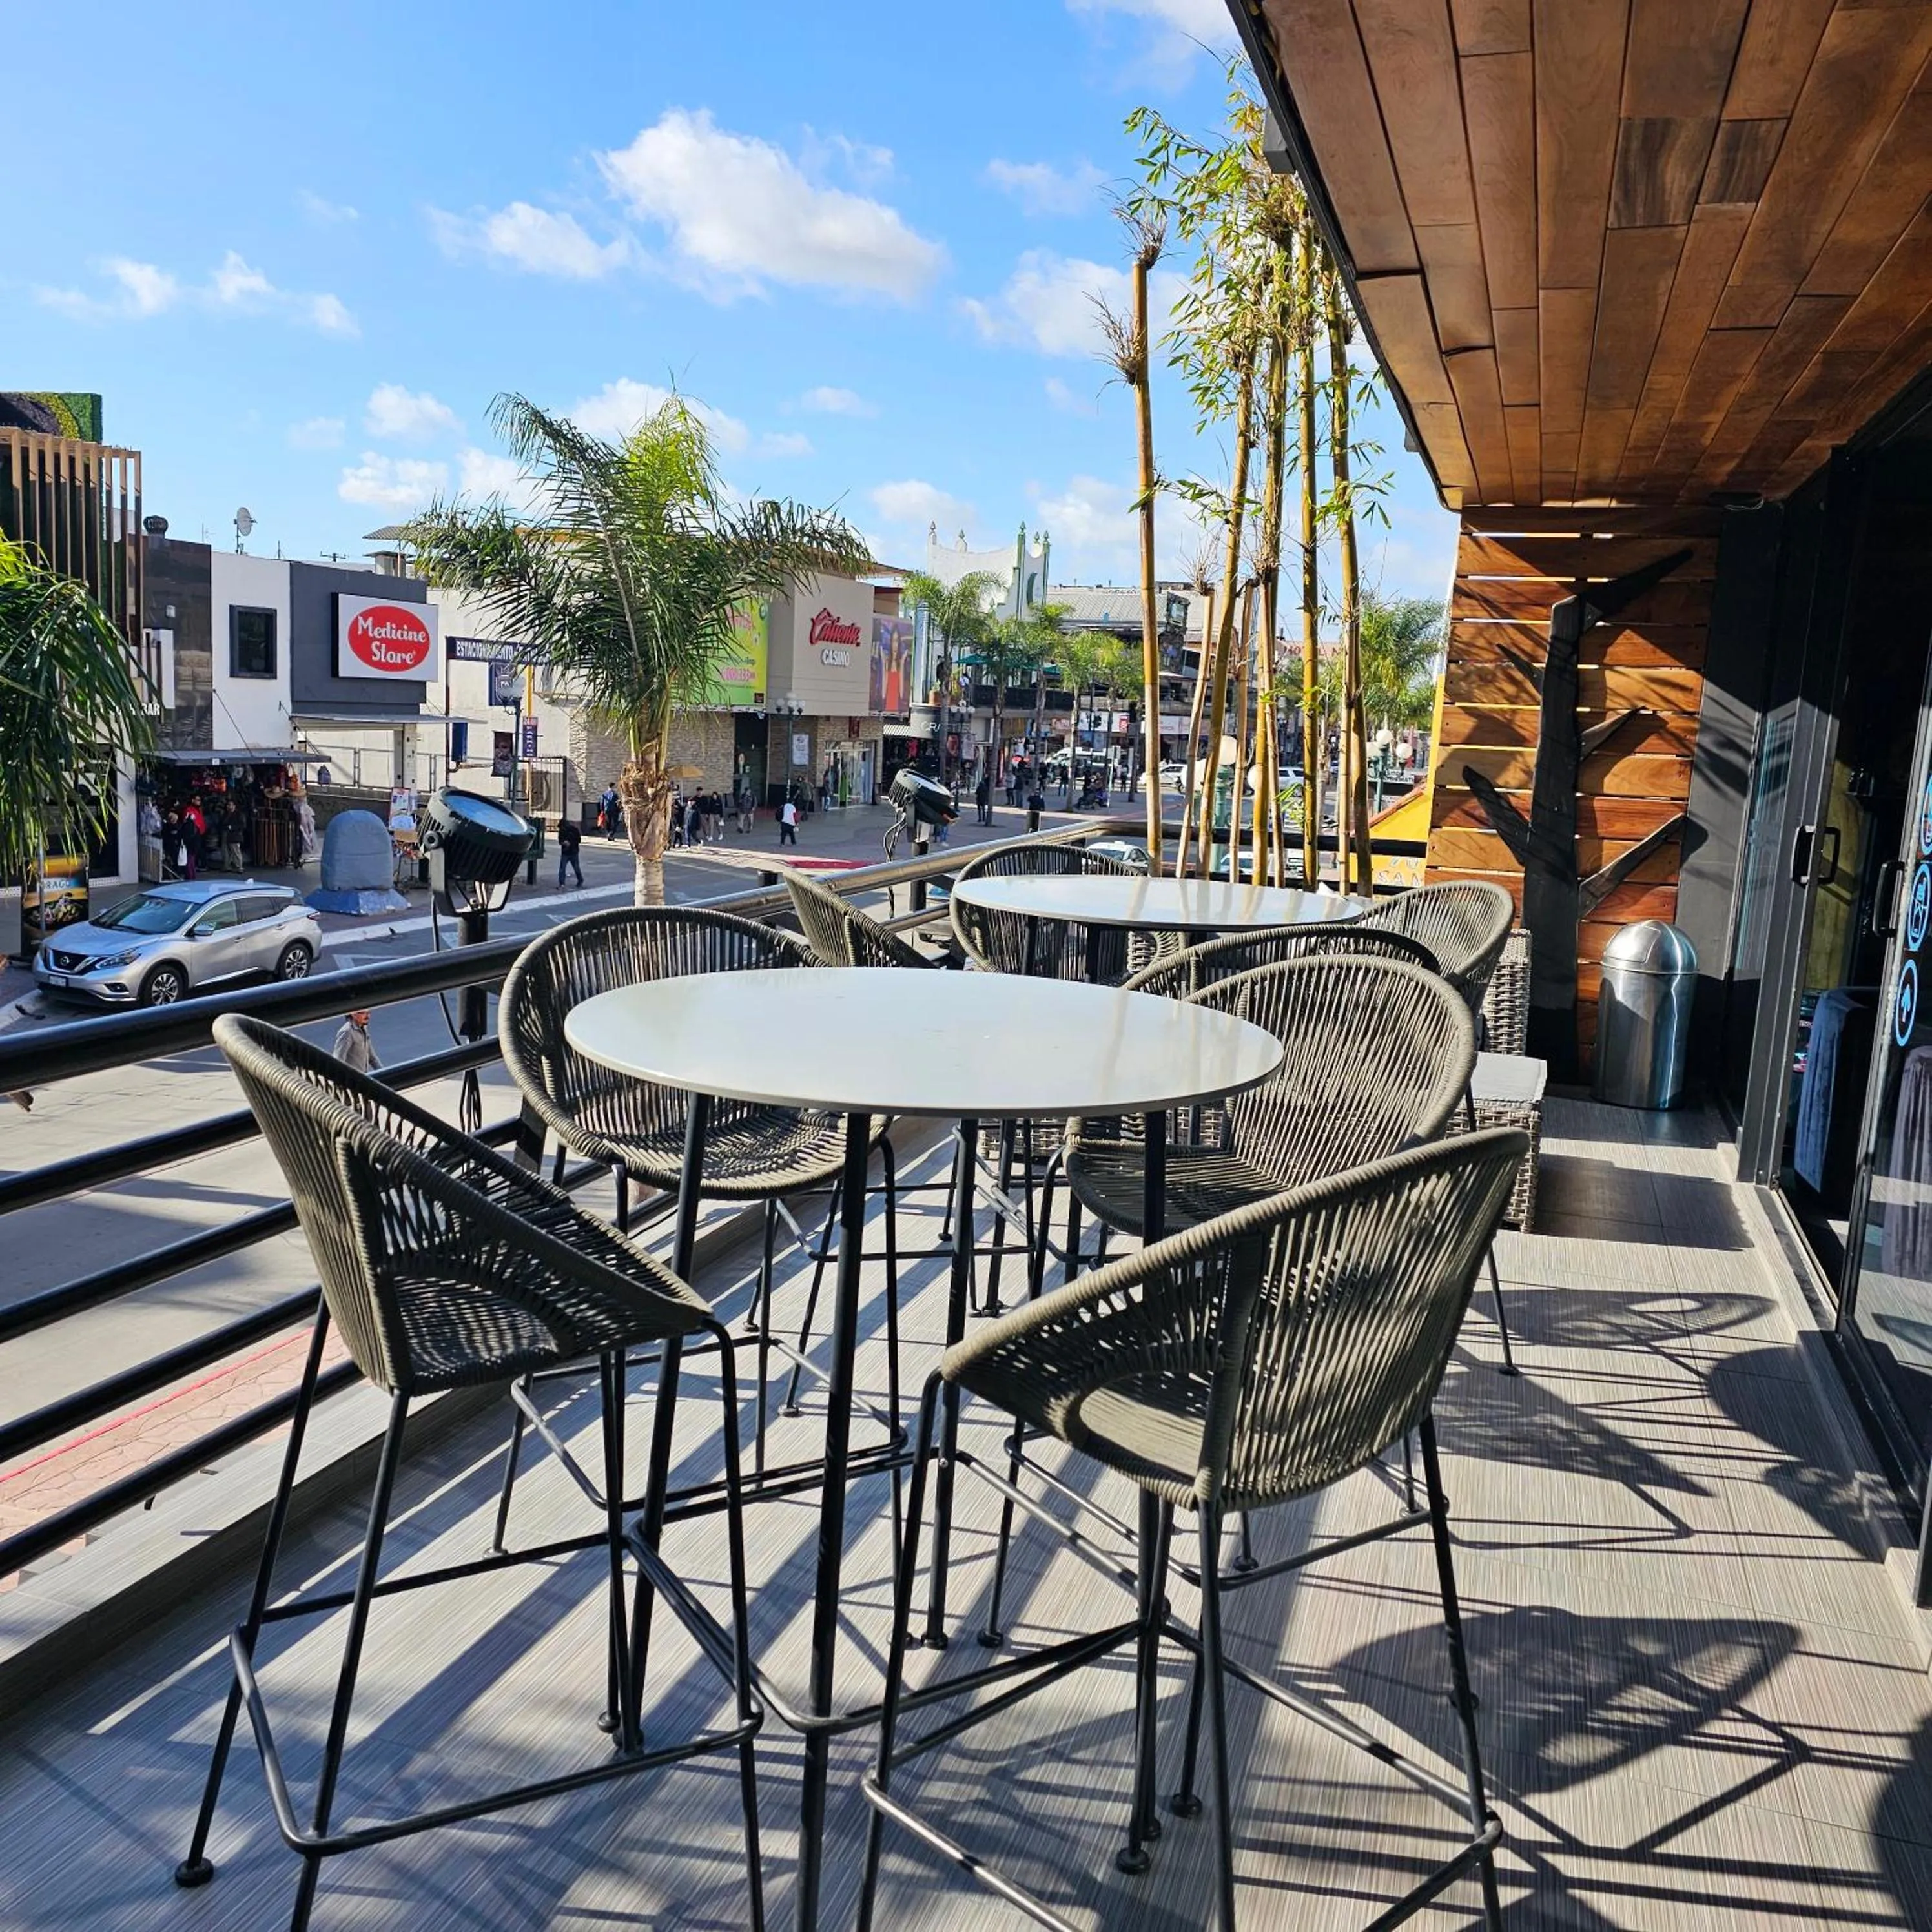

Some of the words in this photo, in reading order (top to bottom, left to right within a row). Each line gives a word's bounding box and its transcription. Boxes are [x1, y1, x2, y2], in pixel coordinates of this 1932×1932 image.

[357, 615, 427, 642] Medicine
[371, 641, 413, 664] Store
[821, 649, 849, 666] CASINO
